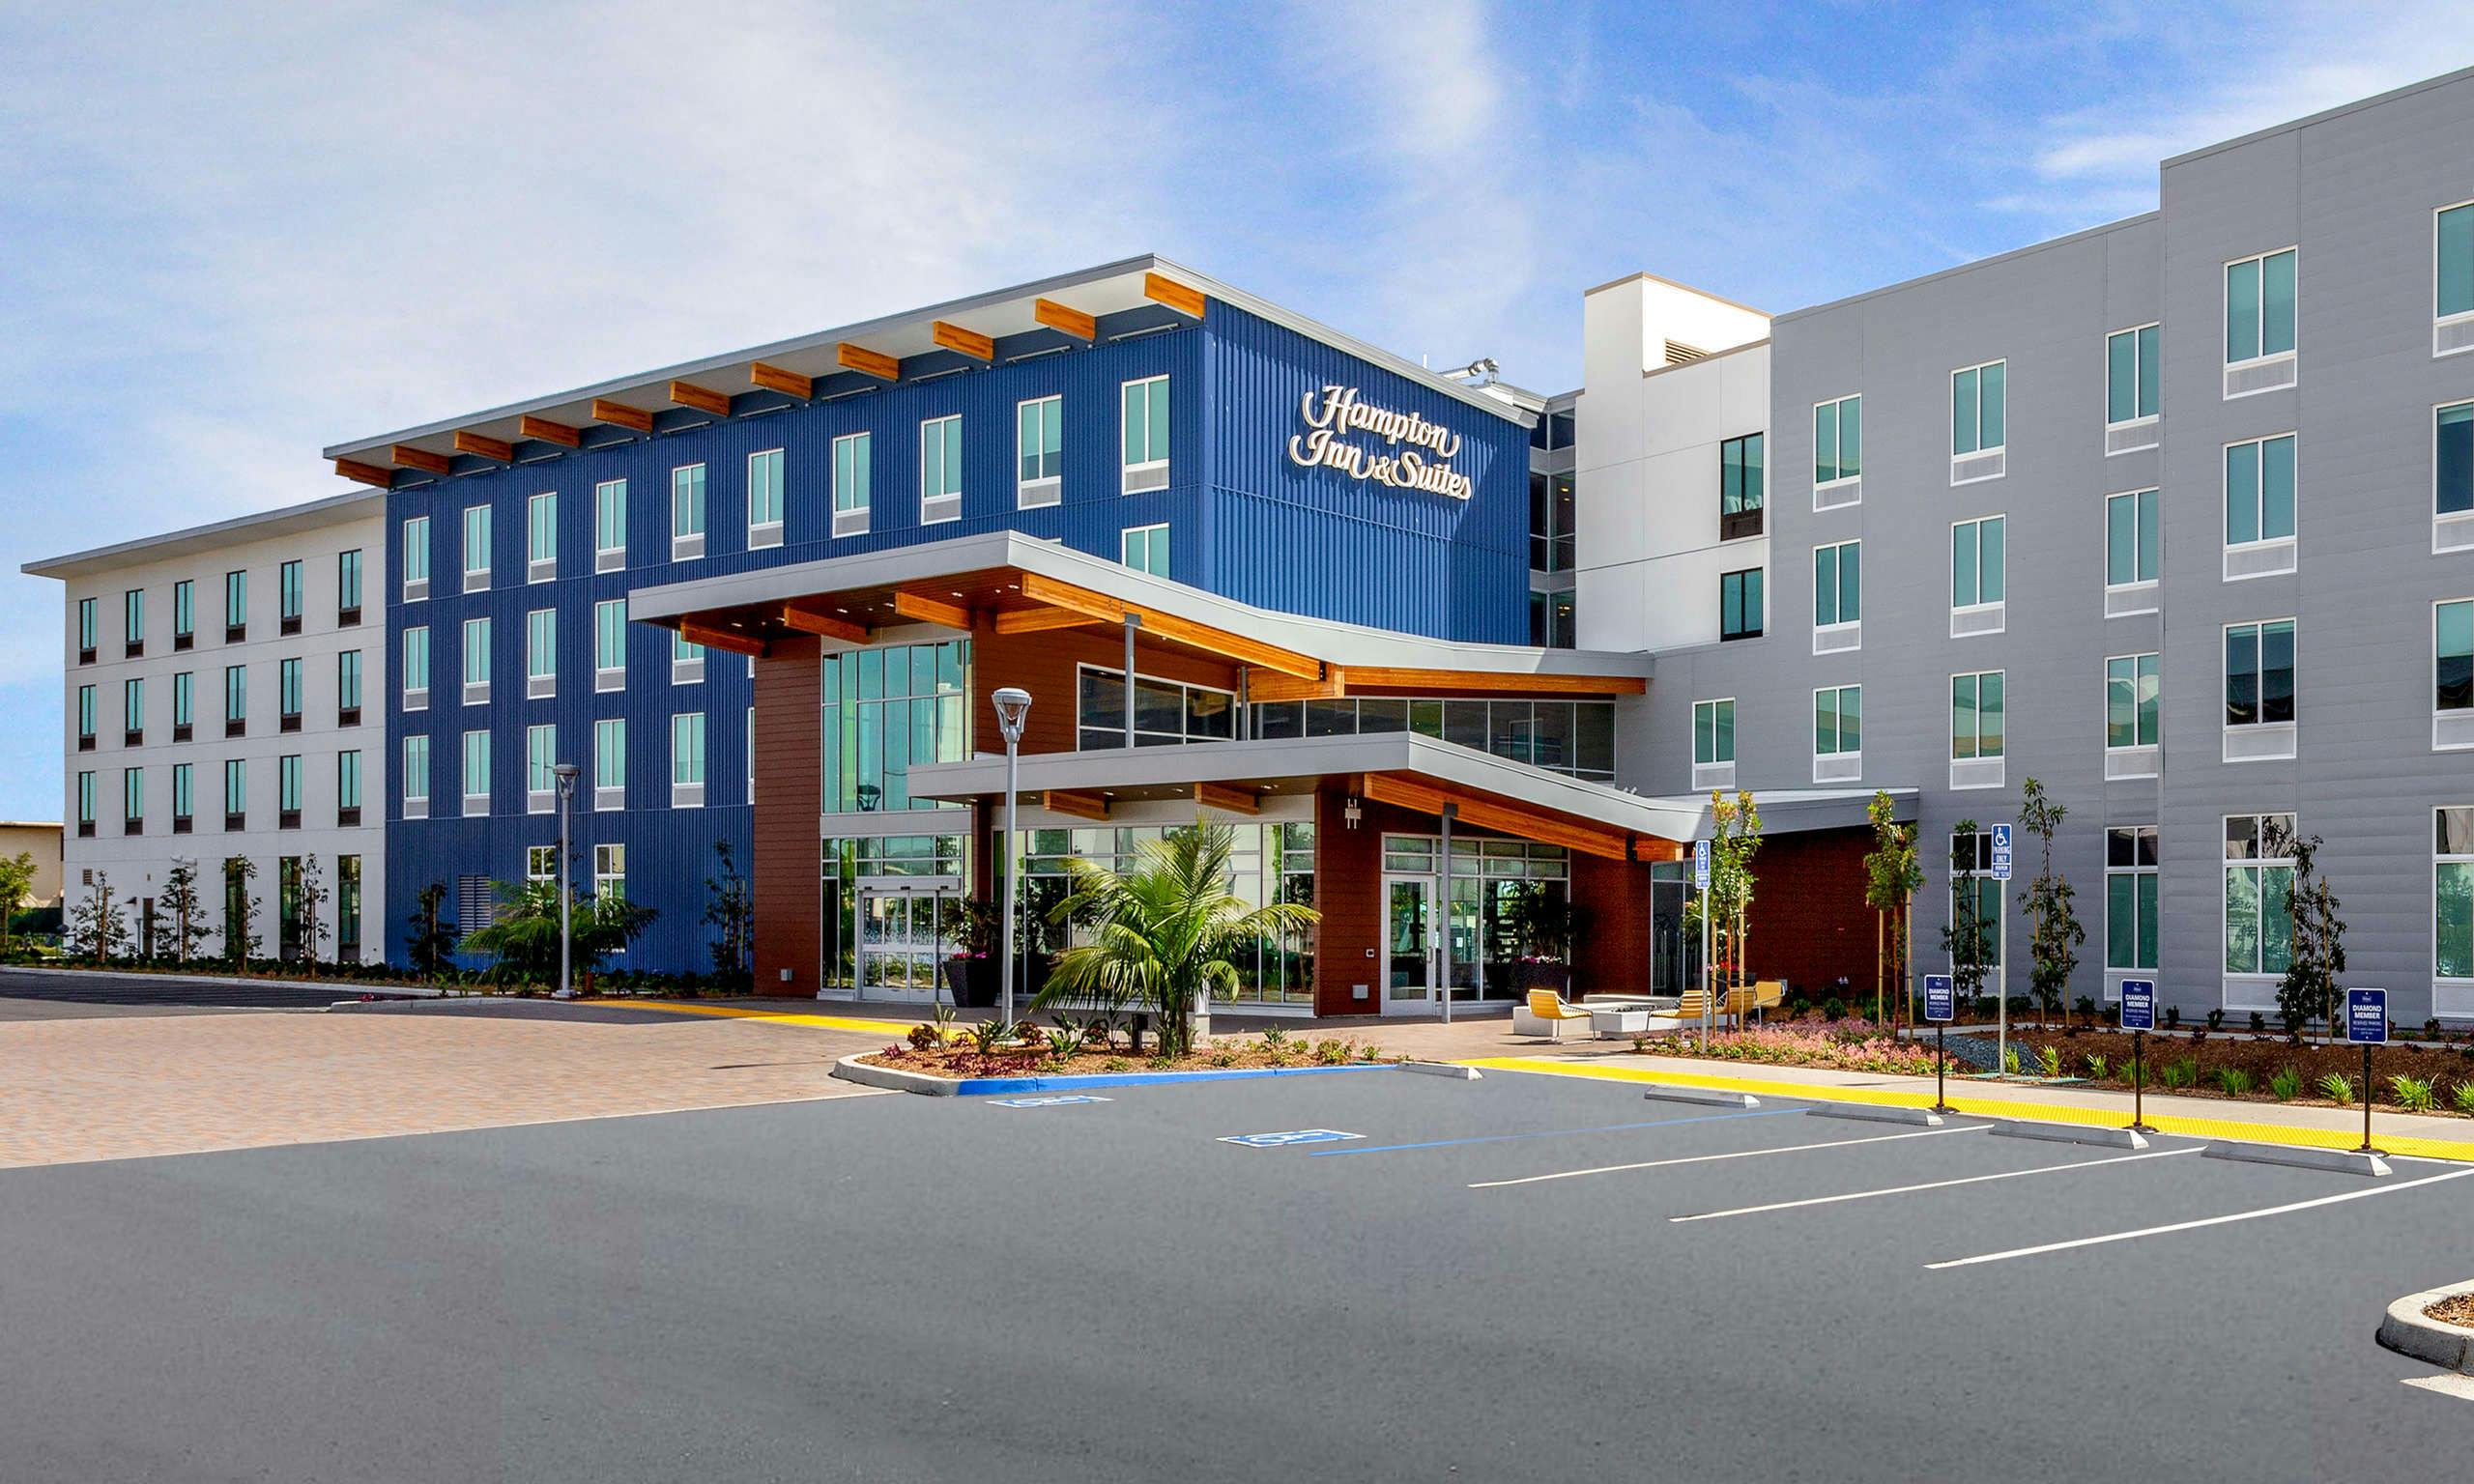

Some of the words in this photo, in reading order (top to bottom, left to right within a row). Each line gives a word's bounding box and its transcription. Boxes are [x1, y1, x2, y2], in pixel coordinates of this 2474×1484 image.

[1302, 385, 1461, 459] Hampton
[1288, 429, 1376, 480] Inn
[1391, 451, 1473, 501] Suites
